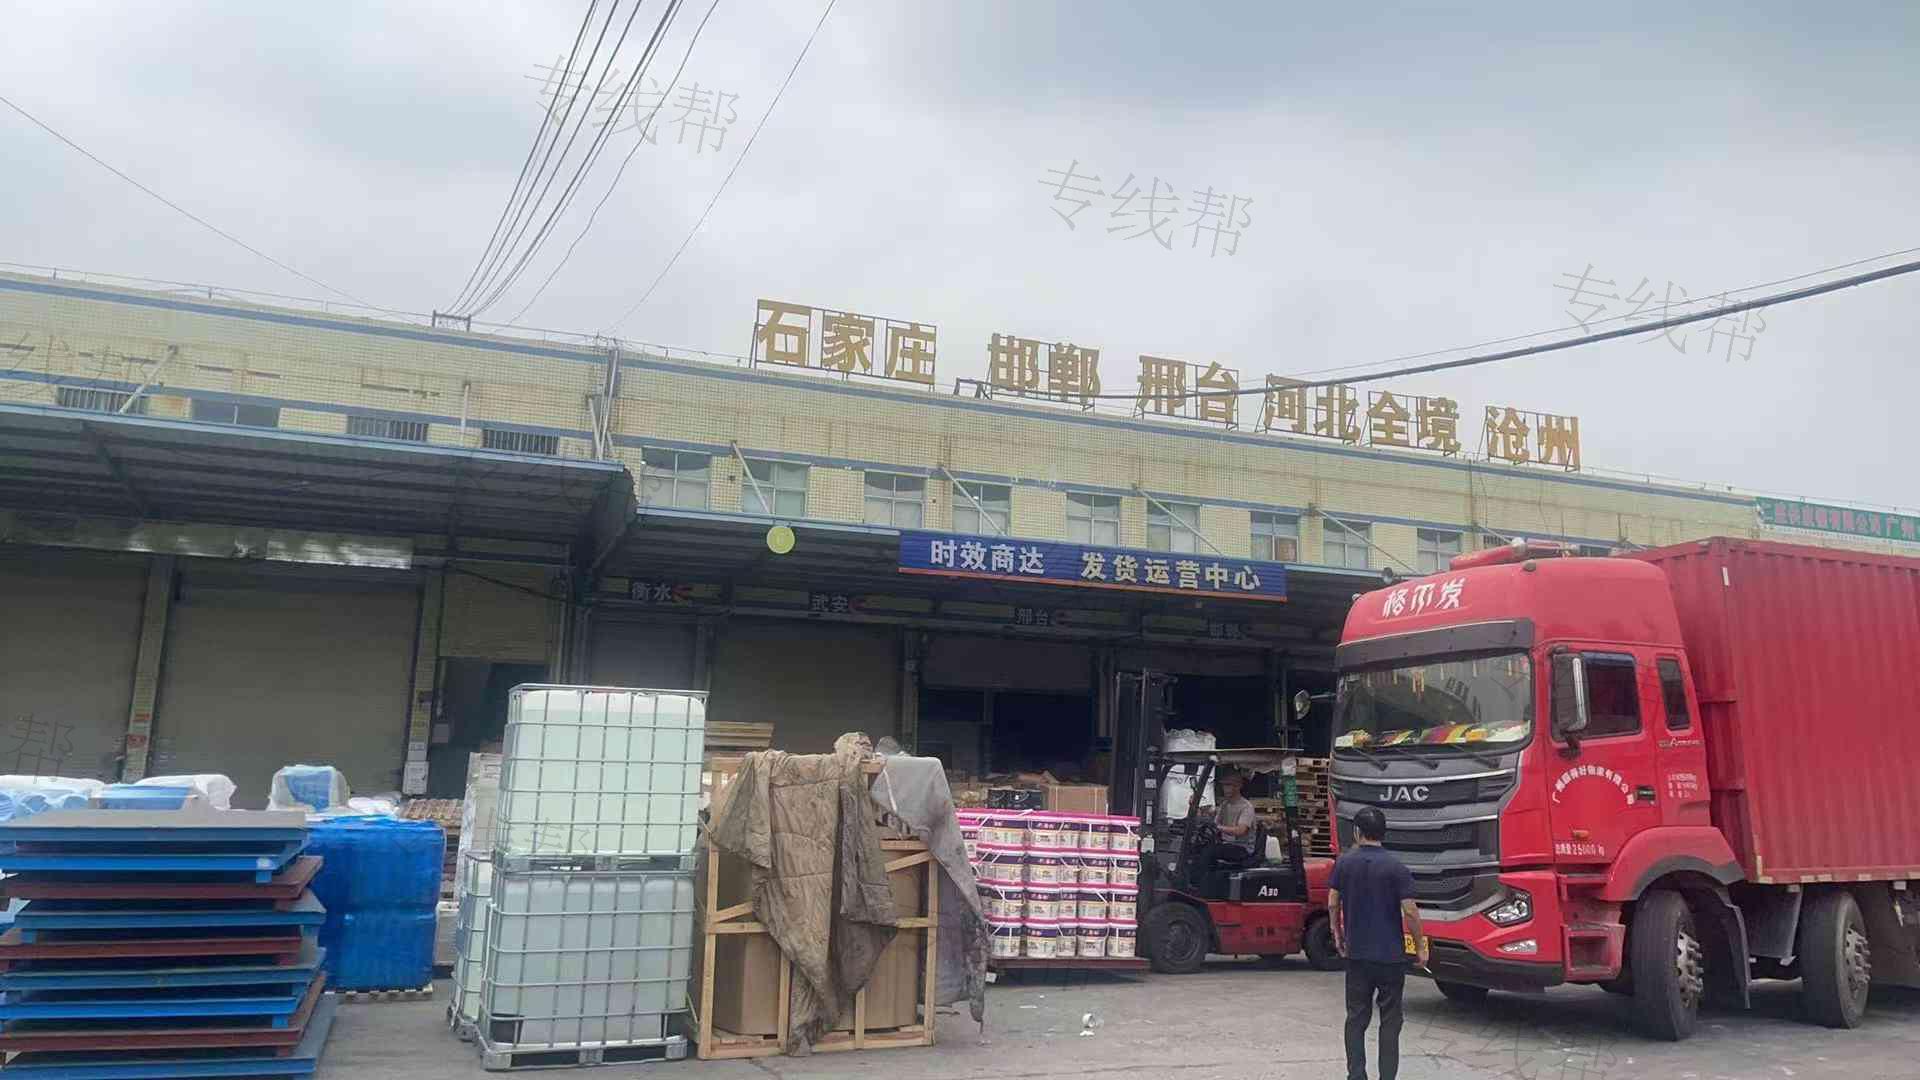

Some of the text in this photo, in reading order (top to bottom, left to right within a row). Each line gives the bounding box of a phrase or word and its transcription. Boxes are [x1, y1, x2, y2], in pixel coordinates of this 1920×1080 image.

[758, 301, 1580, 470] 石家庄 邯郸 邢台 河北全境 沧州
[930, 539, 1261, 591] 时效商达 发货运营中心
[632, 581, 672, 600] 衡水
[1382, 578, 1466, 618] 格尔发
[1379, 785, 1430, 802] JAC
[1258, 885, 1279, 897] A30
